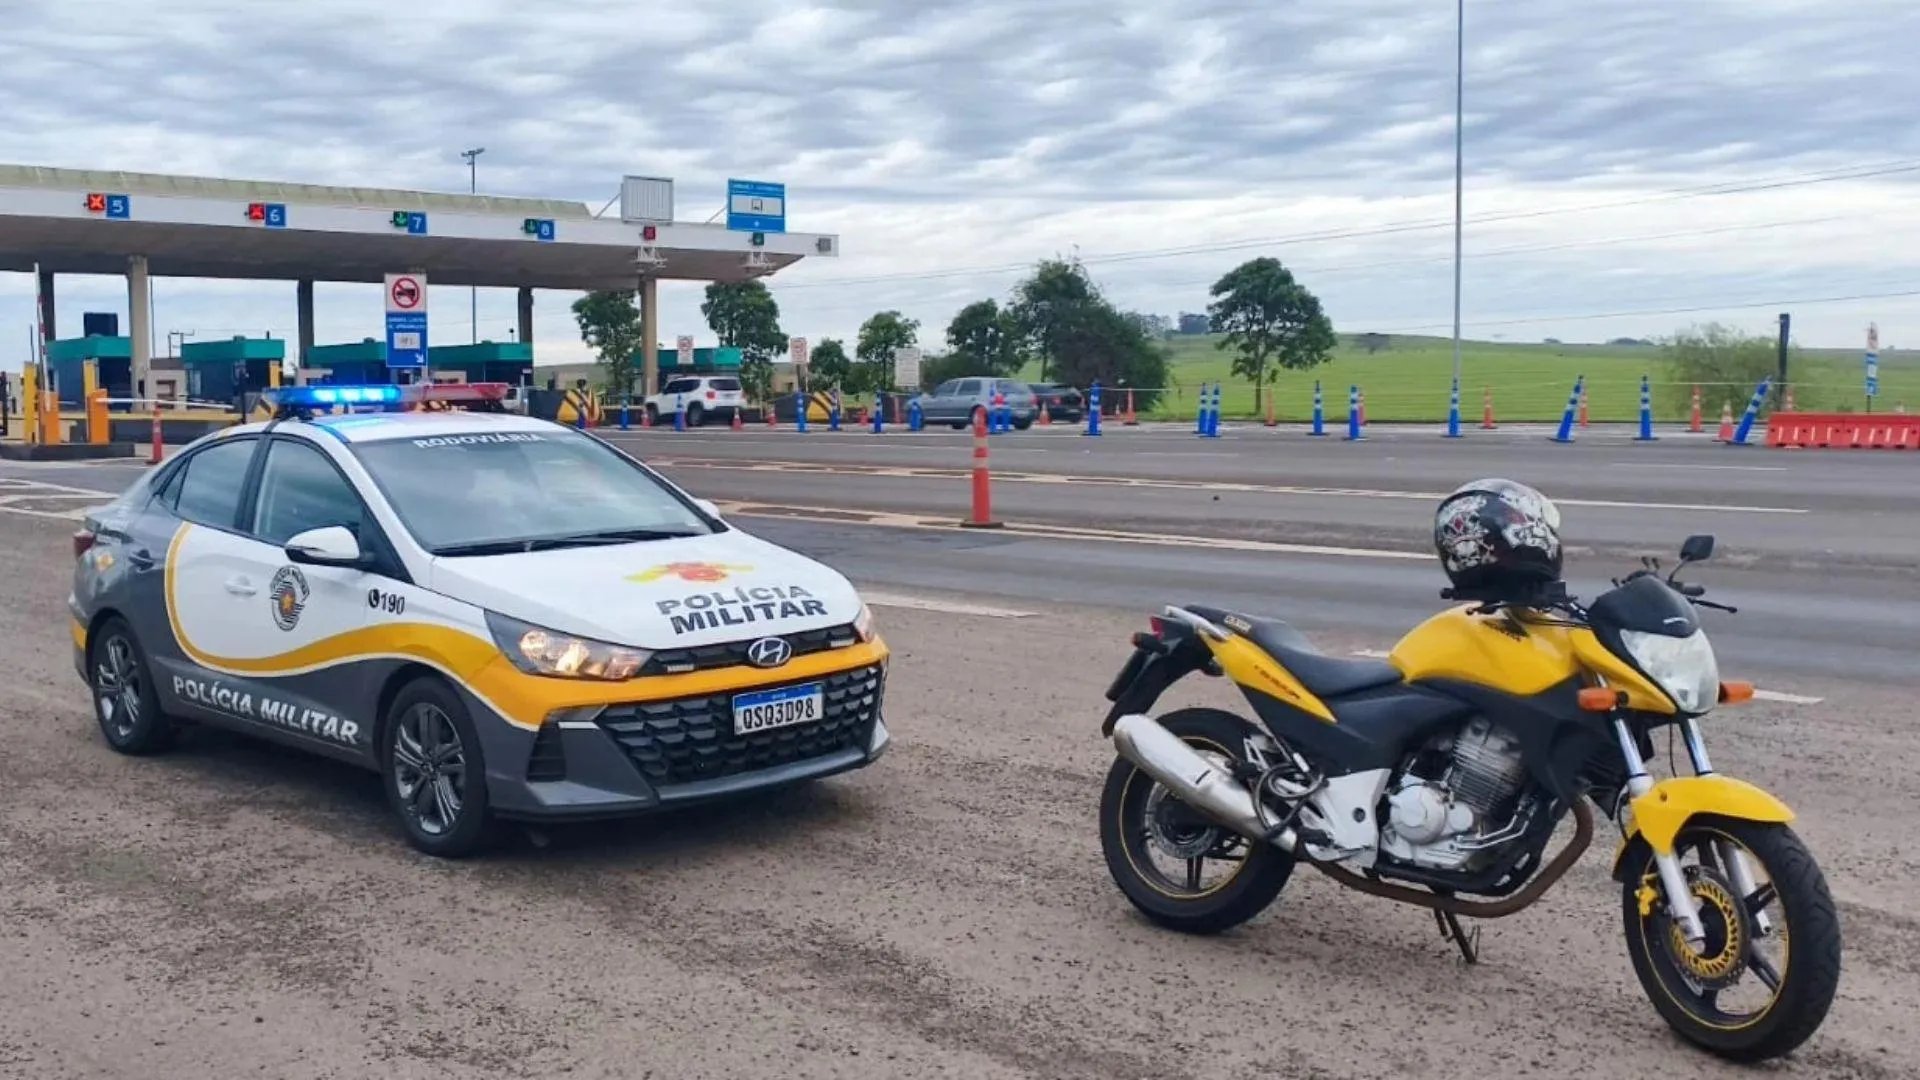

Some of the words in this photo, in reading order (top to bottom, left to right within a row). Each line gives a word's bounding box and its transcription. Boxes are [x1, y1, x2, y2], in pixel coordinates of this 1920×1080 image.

[112, 199, 123, 213] 5
[270, 208, 280, 222] 6
[412, 216, 422, 230] 7
[380, 592, 405, 615] 190
[656, 584, 814, 615] POLÍCIA
[670, 599, 828, 635] MILITAR
[172, 675, 255, 716] POLÍCIA
[260, 698, 360, 745] MILITAR
